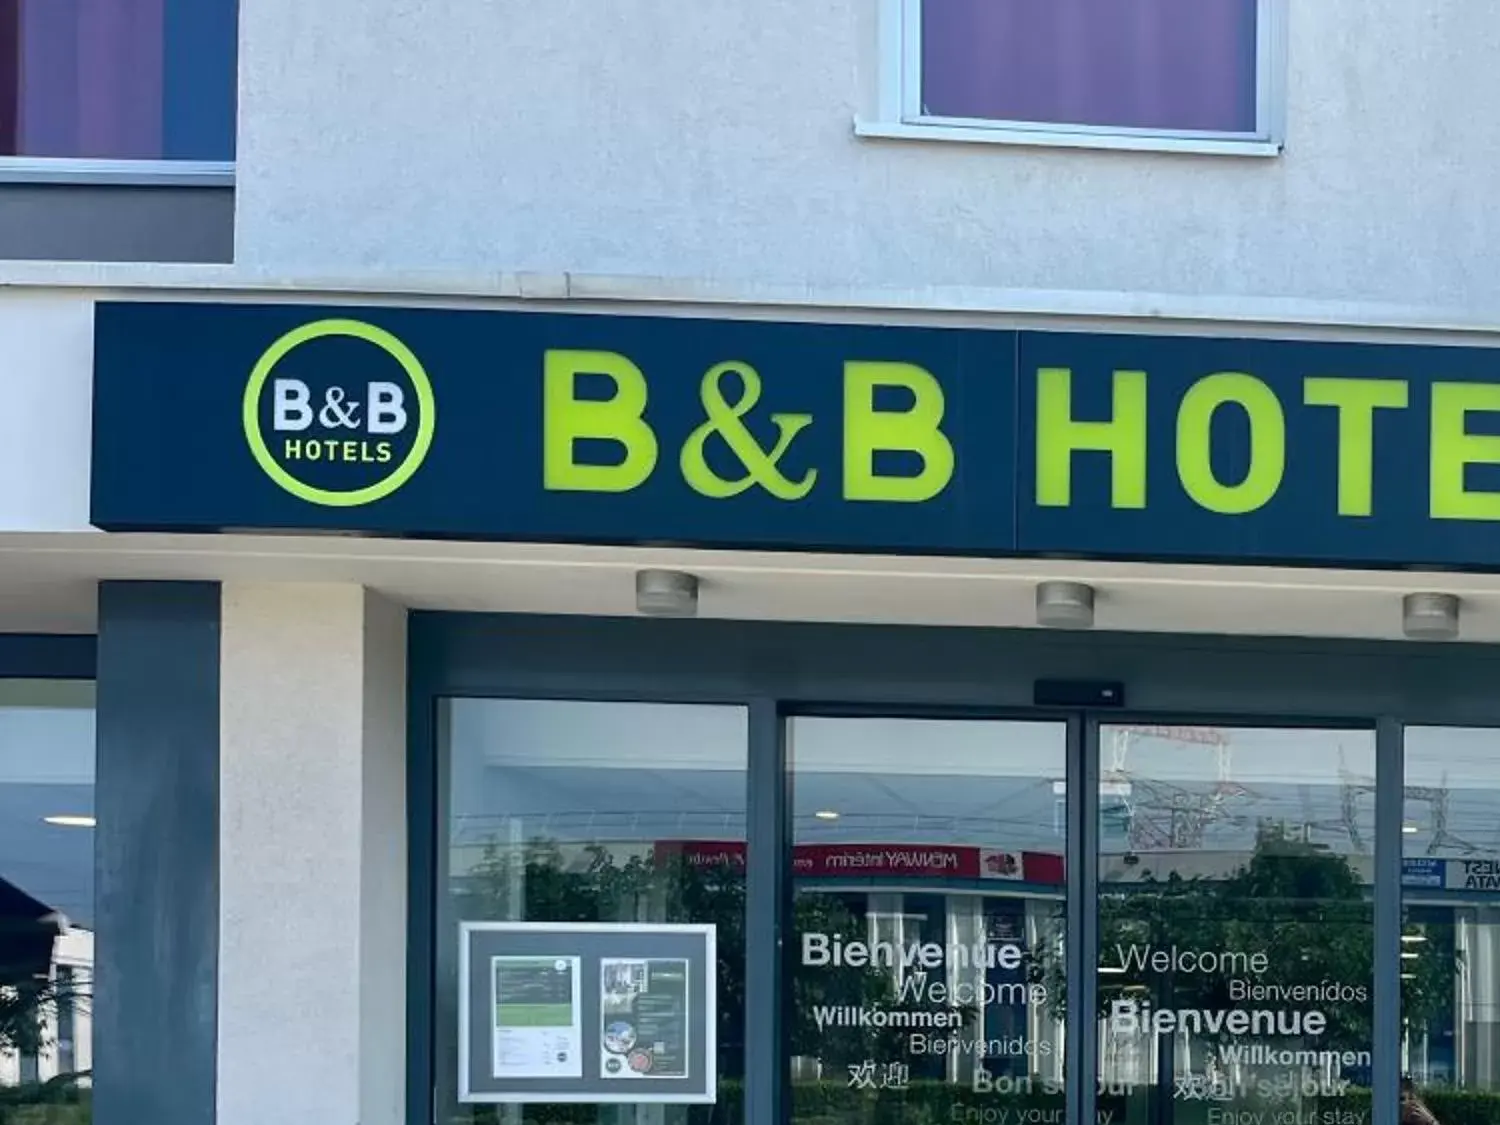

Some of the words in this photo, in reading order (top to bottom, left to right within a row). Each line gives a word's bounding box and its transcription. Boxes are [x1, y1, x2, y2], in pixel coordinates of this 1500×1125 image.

[272, 378, 408, 434] B&B
[543, 348, 956, 503] B&B
[284, 438, 392, 464] HOTELS
[801, 932, 1022, 969] Bienvenue
[1114, 943, 1270, 974] Welcome
[896, 971, 1049, 1005] Welcome
[1229, 979, 1368, 1001] Bienvenidos
[813, 1005, 963, 1028] Willkommen
[1110, 999, 1328, 1036] Bienvenue
[909, 1033, 1053, 1055] Bienvenidos
[1218, 1044, 1372, 1067] Willkommen
[847, 1059, 910, 1090] 欢迎
[973, 1067, 1033, 1094] Bon
